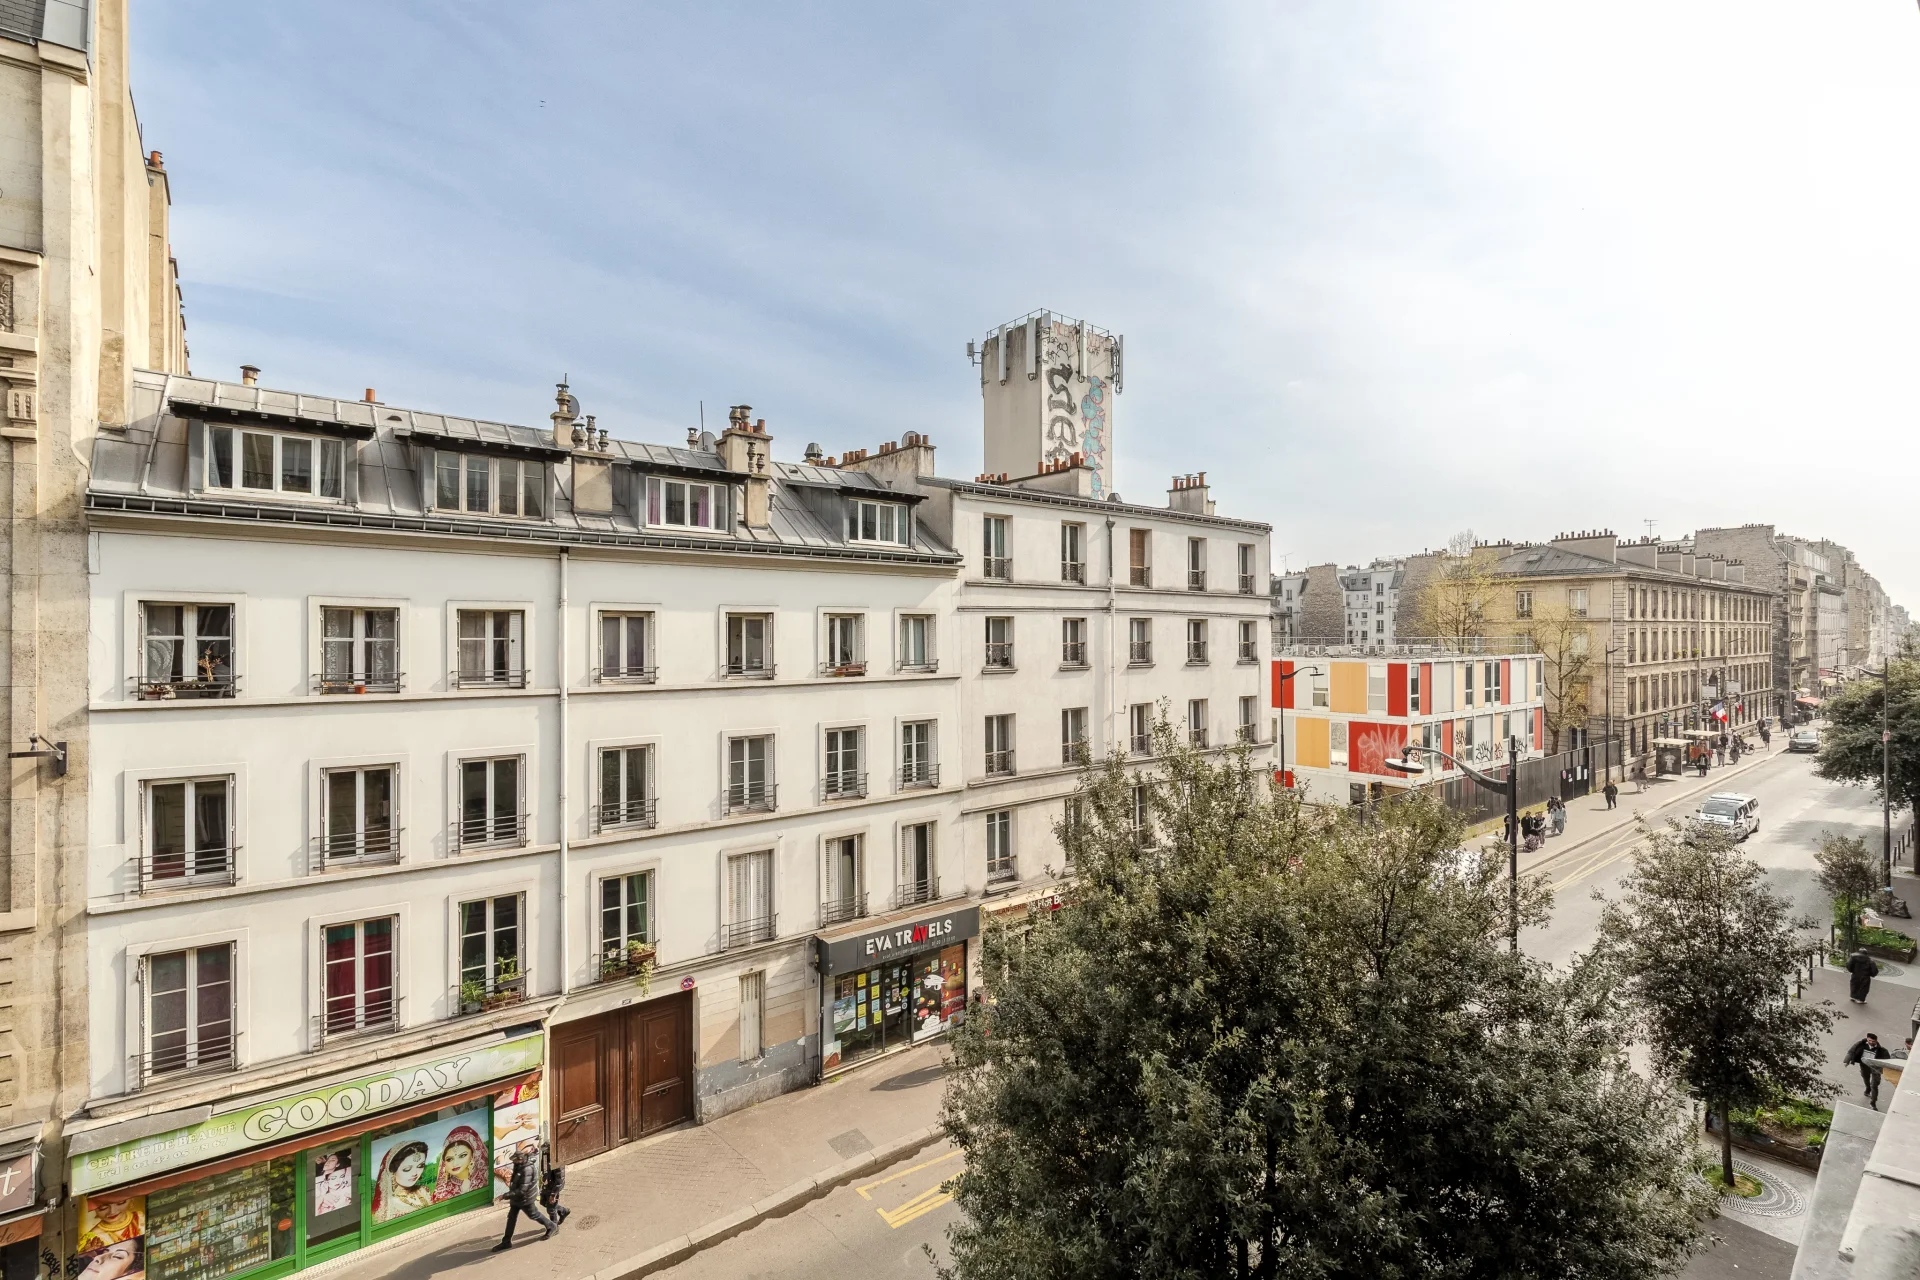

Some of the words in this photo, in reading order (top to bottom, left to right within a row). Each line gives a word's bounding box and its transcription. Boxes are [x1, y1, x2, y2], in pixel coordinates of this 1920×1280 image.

[866, 934, 892, 955] EVA
[895, 919, 952, 947] TRAVELS
[243, 1057, 471, 1141] GOODAY
[86, 1146, 151, 1171] CENTRE
[152, 1138, 176, 1154] DE
[177, 1120, 236, 1149] BEAUTÉ
[131, 1160, 150, 1171] 01
[153, 1154, 170, 1166] 42
[173, 1148, 191, 1159] 05
[194, 1142, 210, 1156] 78
[211, 1137, 229, 1149] 67
